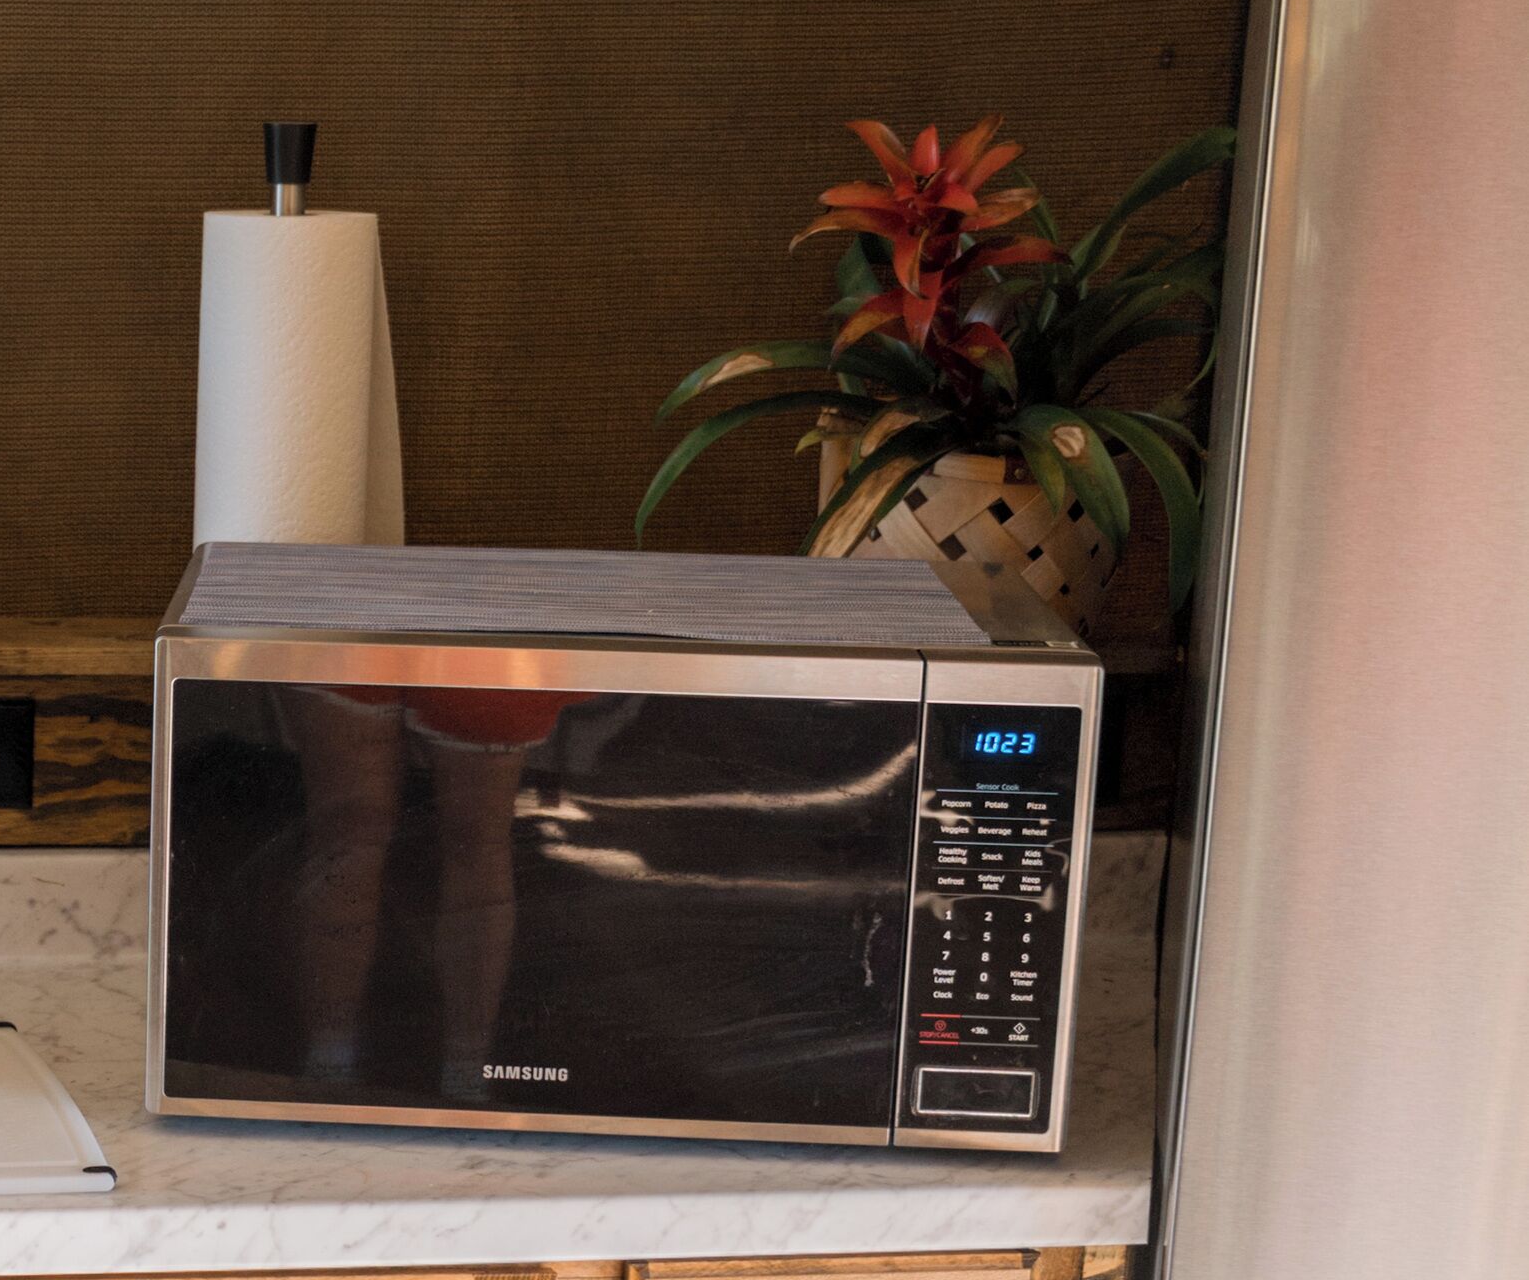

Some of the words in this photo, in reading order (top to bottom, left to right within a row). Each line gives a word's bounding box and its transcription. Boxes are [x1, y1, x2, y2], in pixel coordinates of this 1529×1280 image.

[976, 783, 1000, 791] Sensor
[1001, 783, 1020, 791] Cook
[942, 800, 971, 808] Popcorn
[985, 801, 1009, 809] Potato
[1027, 802, 1047, 810] Pizza
[941, 826, 969, 834] Veggies
[978, 827, 1012, 836] Beverage
[1022, 828, 1047, 836] Reheat
[939, 848, 967, 856] Healthy
[1025, 850, 1041, 858] Kids
[938, 855, 967, 865] Cooking
[981, 853, 1003, 861] Snack
[1021, 858, 1043, 866] Meals
[938, 877, 965, 885] Defrost
[1022, 876, 1041, 884] Keep
[982, 882, 999, 890] Melt
[1019, 884, 1042, 892] Warm
[945, 910, 952, 920] 1
[984, 912, 992, 921] 2
[1024, 913, 1032, 923] 3
[943, 931, 951, 940] 4
[983, 932, 991, 941] 5
[1022, 933, 1030, 943] 6
[942, 951, 950, 960] 7
[981, 952, 989, 962] 8
[1021, 953, 1029, 963] 9
[933, 968, 956, 976] Power
[1010, 971, 1037, 979] Kitchen
[934, 976, 954, 984] Level
[980, 972, 988, 982] 0
[1012, 979, 1034, 987] Timer
[933, 991, 953, 999] Clock
[976, 992, 990, 1000] Eco
[1011, 994, 1033, 1002] Sound
[482, 1064, 569, 1082] SAMSUNG
